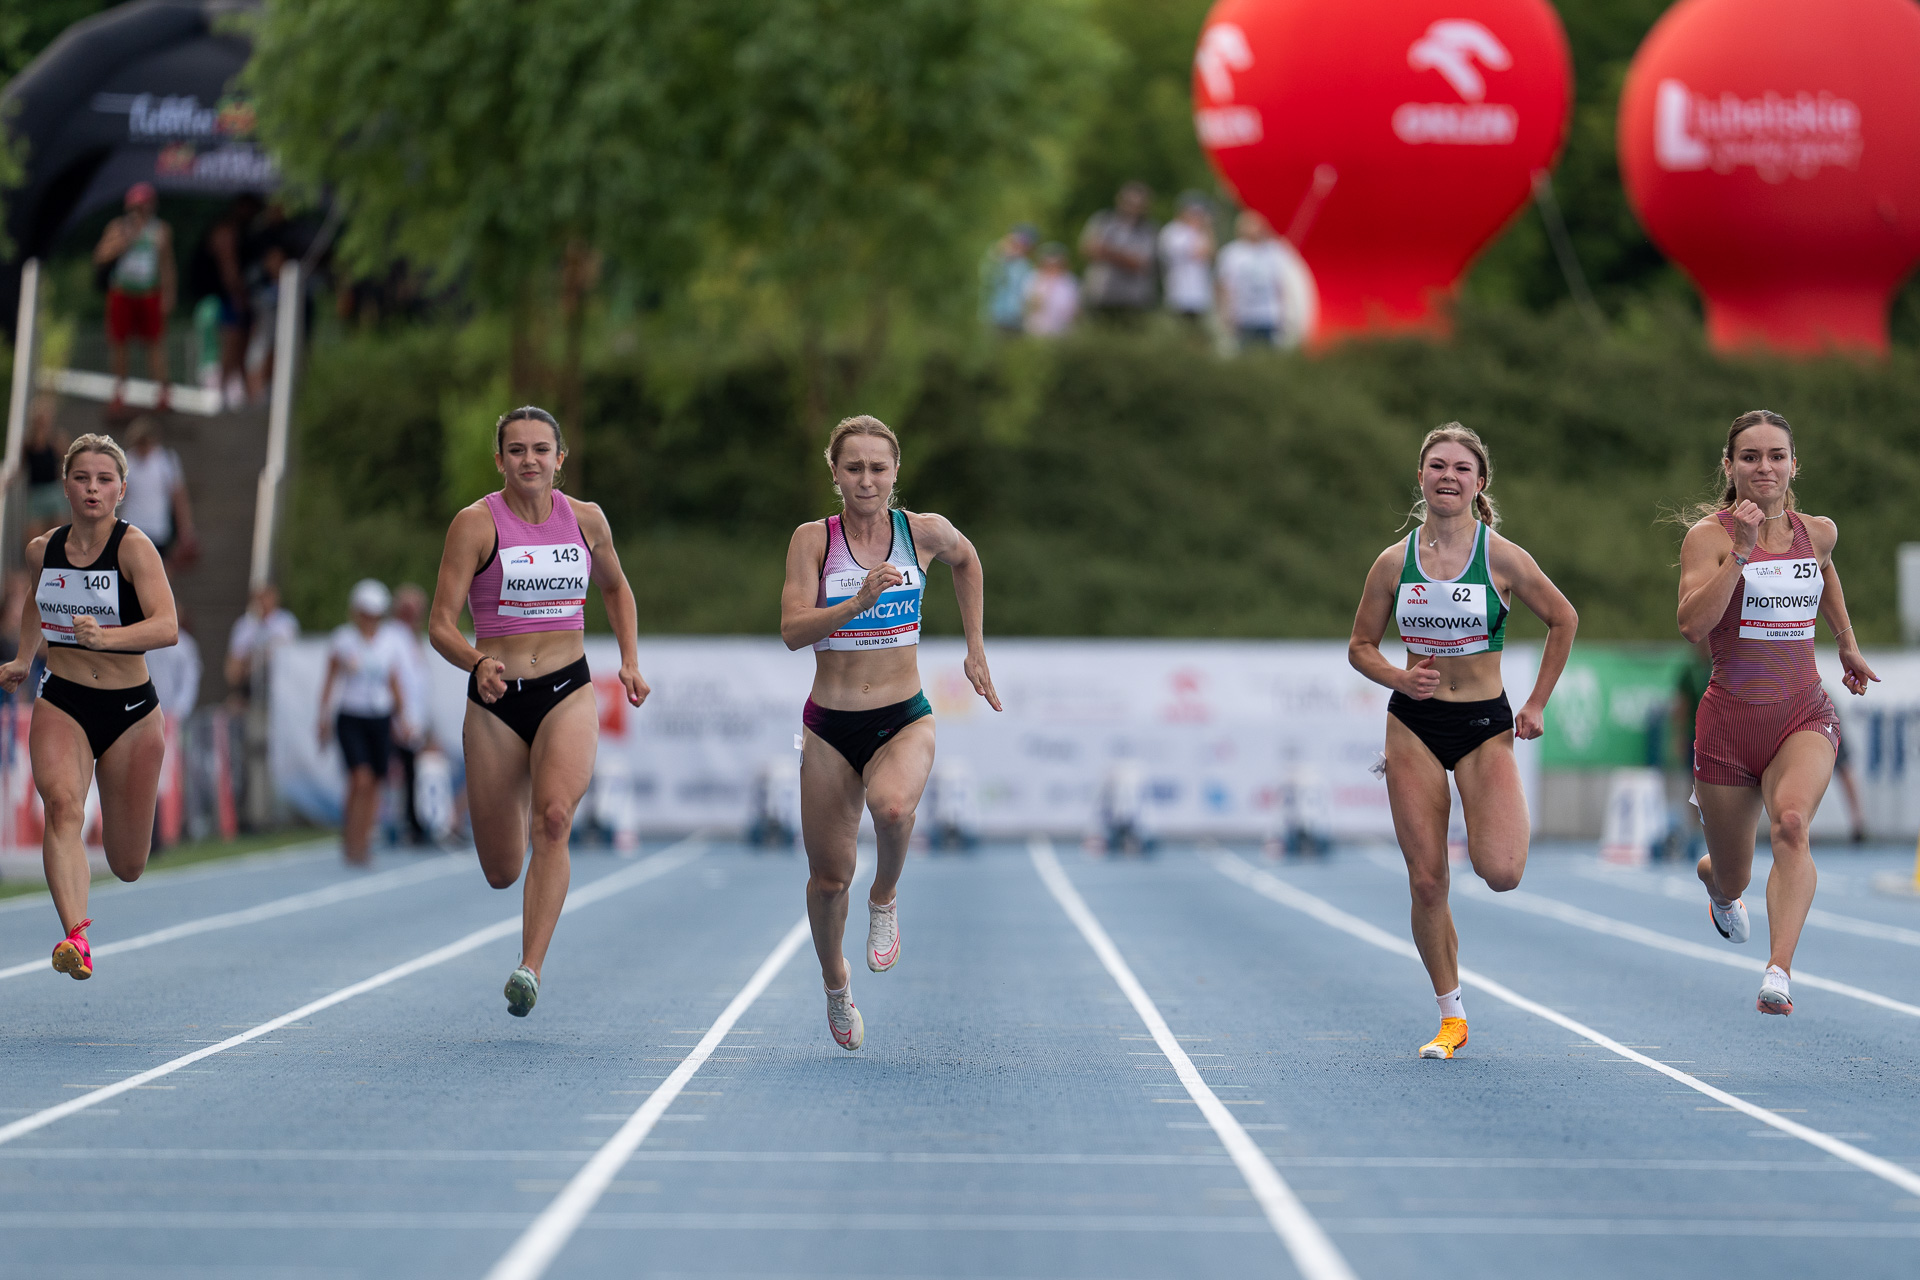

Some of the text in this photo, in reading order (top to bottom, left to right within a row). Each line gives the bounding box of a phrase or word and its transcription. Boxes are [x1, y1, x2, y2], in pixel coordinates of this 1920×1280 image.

[552, 548, 579, 563] 143
[1793, 563, 1818, 579] 257
[84, 575, 110, 590] 140
[506, 576, 584, 591] KRAWCZYK
[1452, 587, 1472, 602] 62
[1746, 595, 1818, 608] PIOTROWSKA
[40, 602, 115, 616] KWASIBORSKA
[1402, 616, 1482, 629] ŁYSKOWKA
[891, 626, 906, 634] POLSKI
[1424, 646, 1446, 654] LUBLIN
